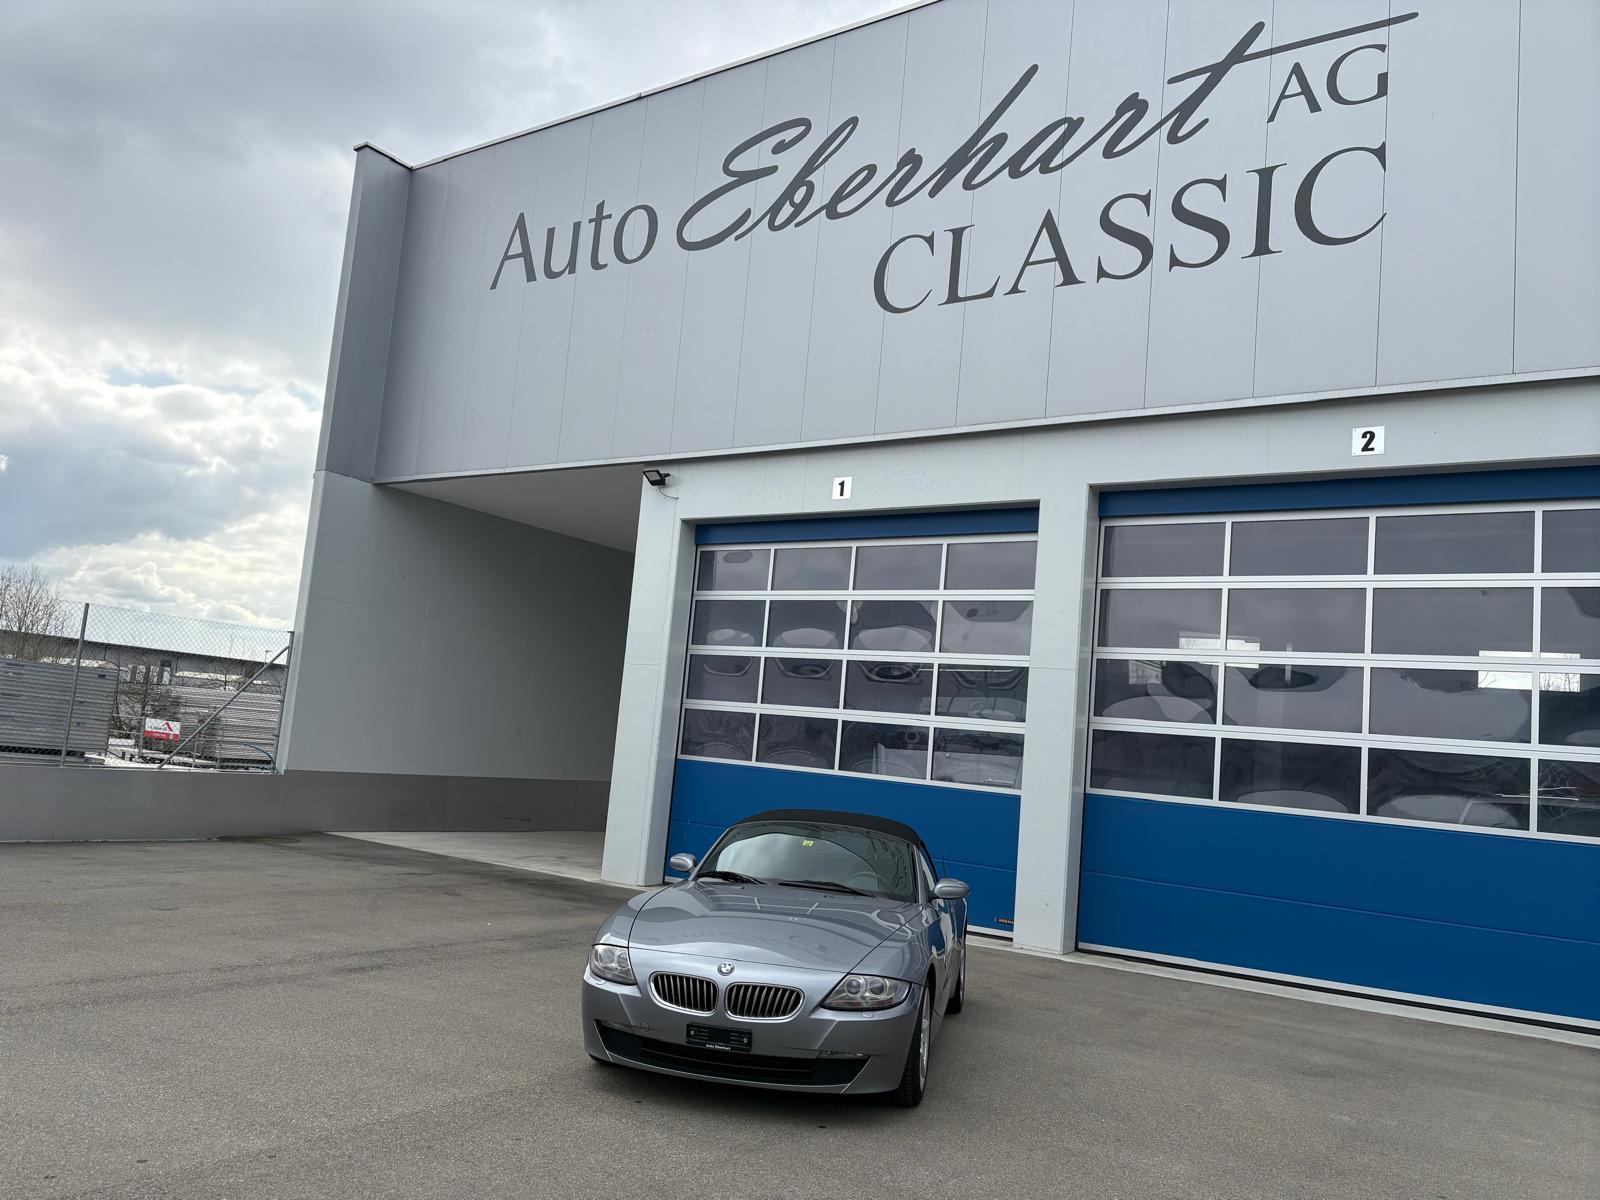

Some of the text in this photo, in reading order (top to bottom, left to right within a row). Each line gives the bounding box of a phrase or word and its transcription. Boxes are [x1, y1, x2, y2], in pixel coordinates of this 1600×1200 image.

[490, 12, 1419, 290] Auto Eberhart AG
[873, 141, 1387, 313] CLASSIC
[838, 480, 845, 497] 1
[1361, 430, 1376, 452] 2
